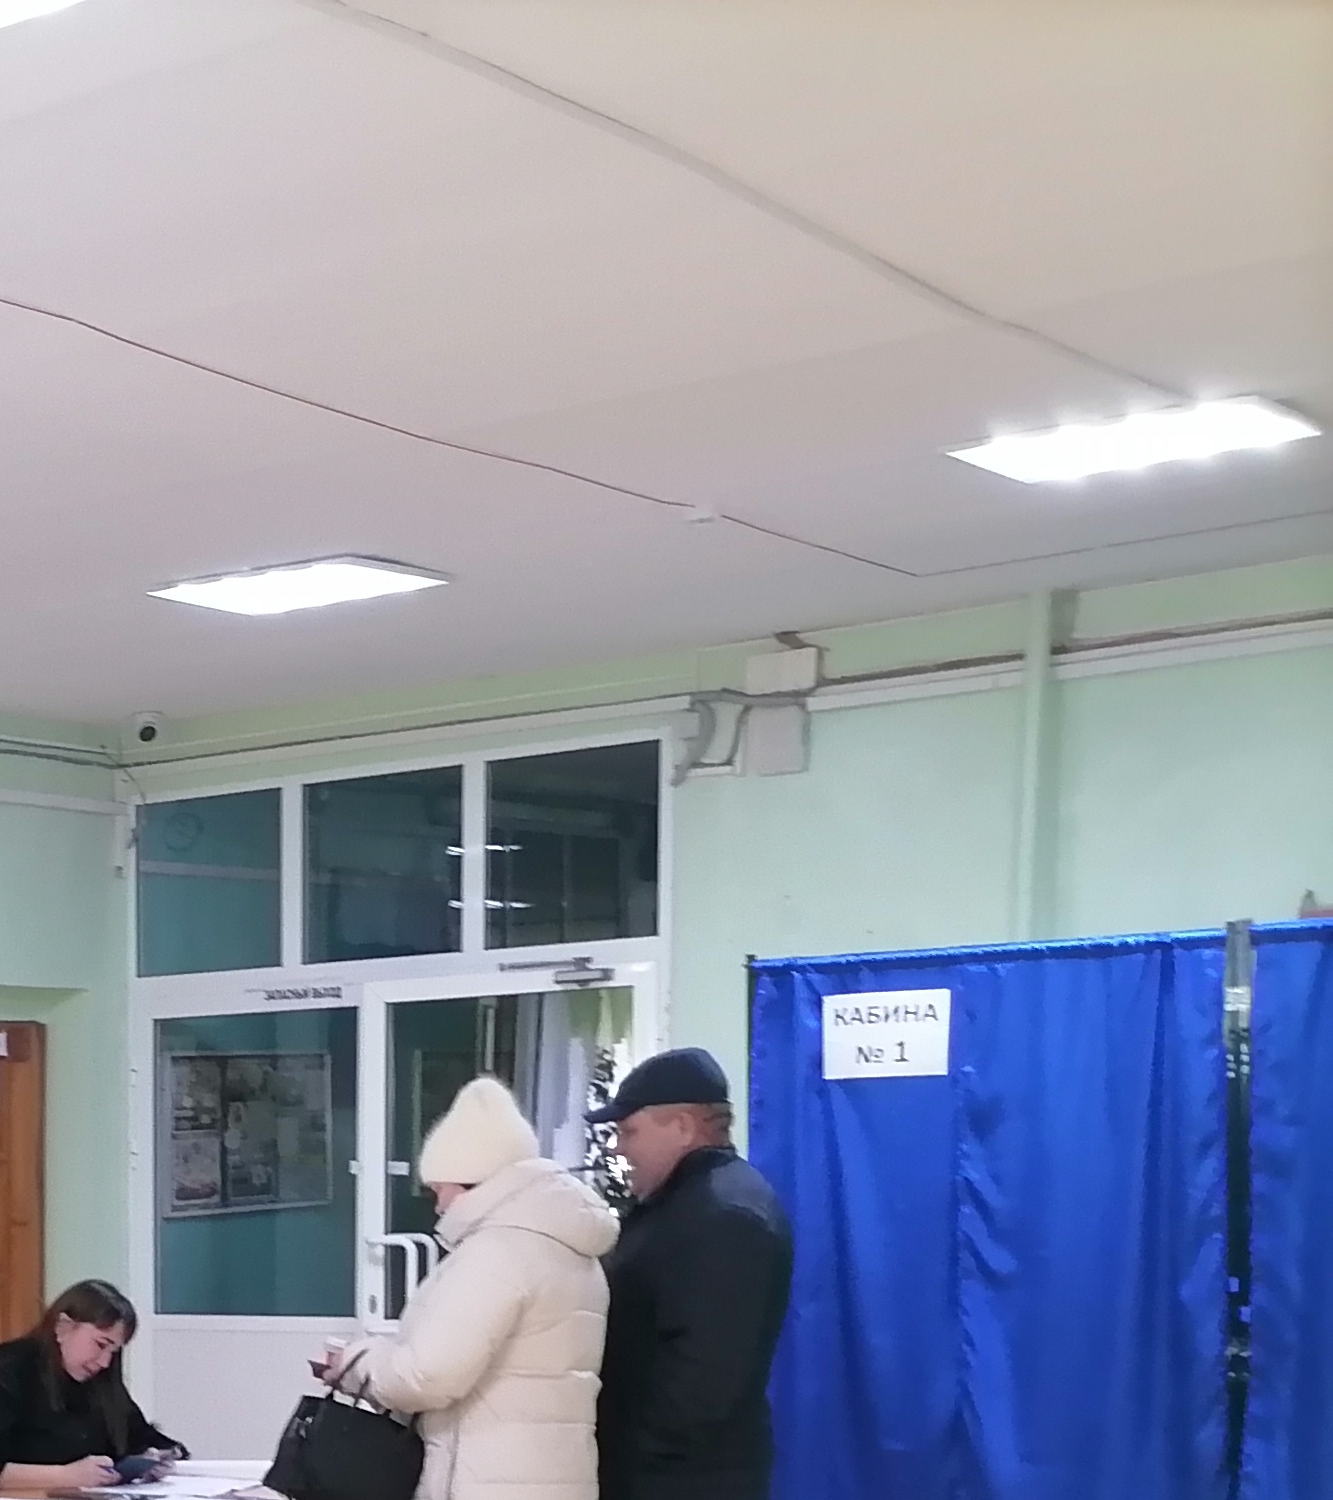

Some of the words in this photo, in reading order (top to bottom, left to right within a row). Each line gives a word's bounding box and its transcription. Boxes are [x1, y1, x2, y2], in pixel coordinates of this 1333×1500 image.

[833, 1004, 939, 1026] КАБИНА
[856, 1046, 884, 1063] №
[894, 1041, 909, 1063] 1
